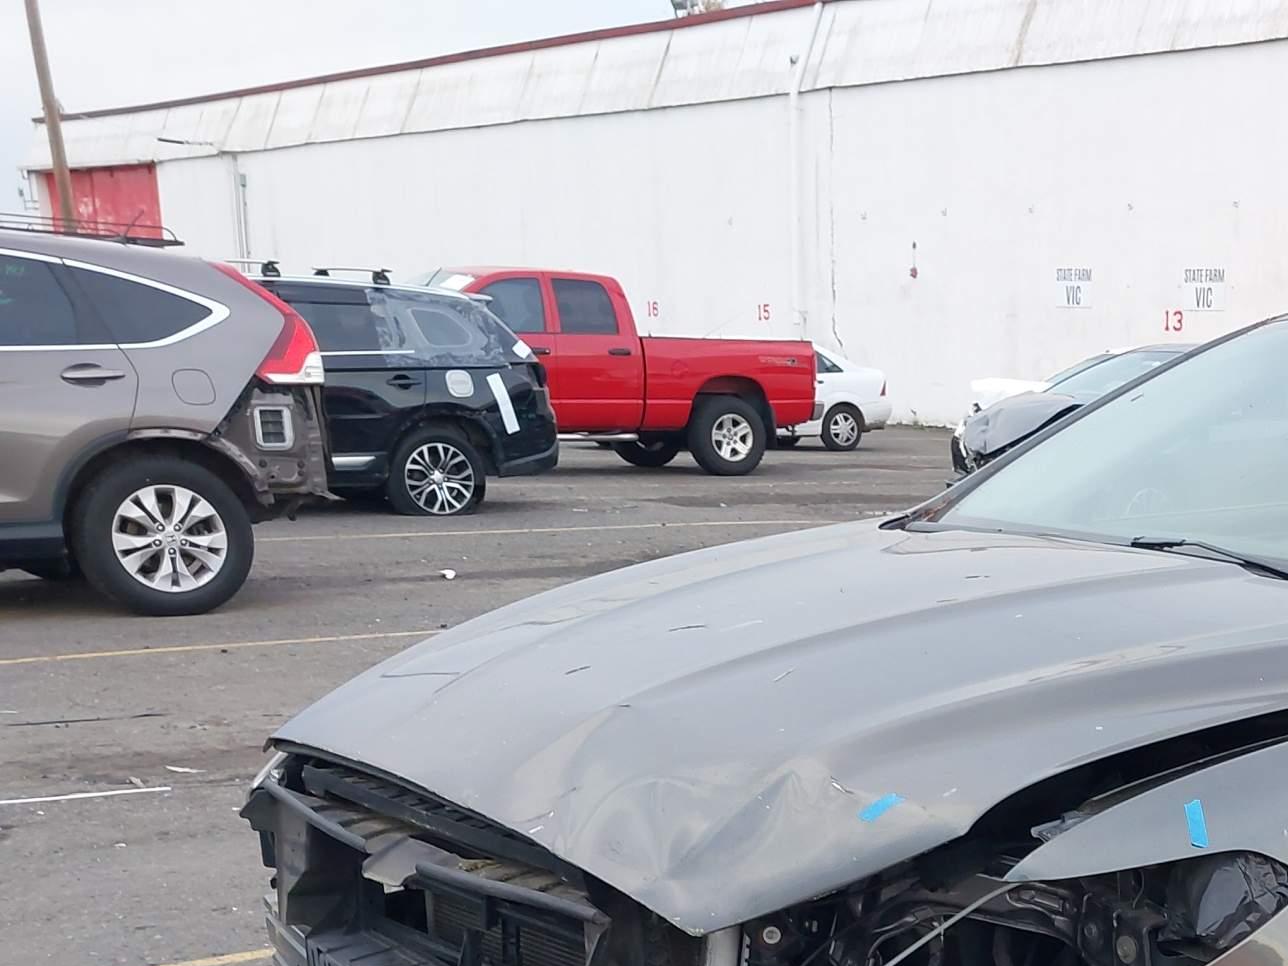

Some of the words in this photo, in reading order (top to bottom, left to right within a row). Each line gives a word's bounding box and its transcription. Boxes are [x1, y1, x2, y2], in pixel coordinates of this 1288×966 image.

[1056, 268, 1073, 282] STATE
[1074, 268, 1092, 282] FARM
[1184, 268, 1203, 283] STATE
[1204, 268, 1225, 283] FARM
[1065, 285, 1081, 305] VIC
[1195, 287, 1213, 308] VIC
[647, 300, 659, 317] 16
[758, 303, 770, 321] 15
[1164, 310, 1184, 332] 13
